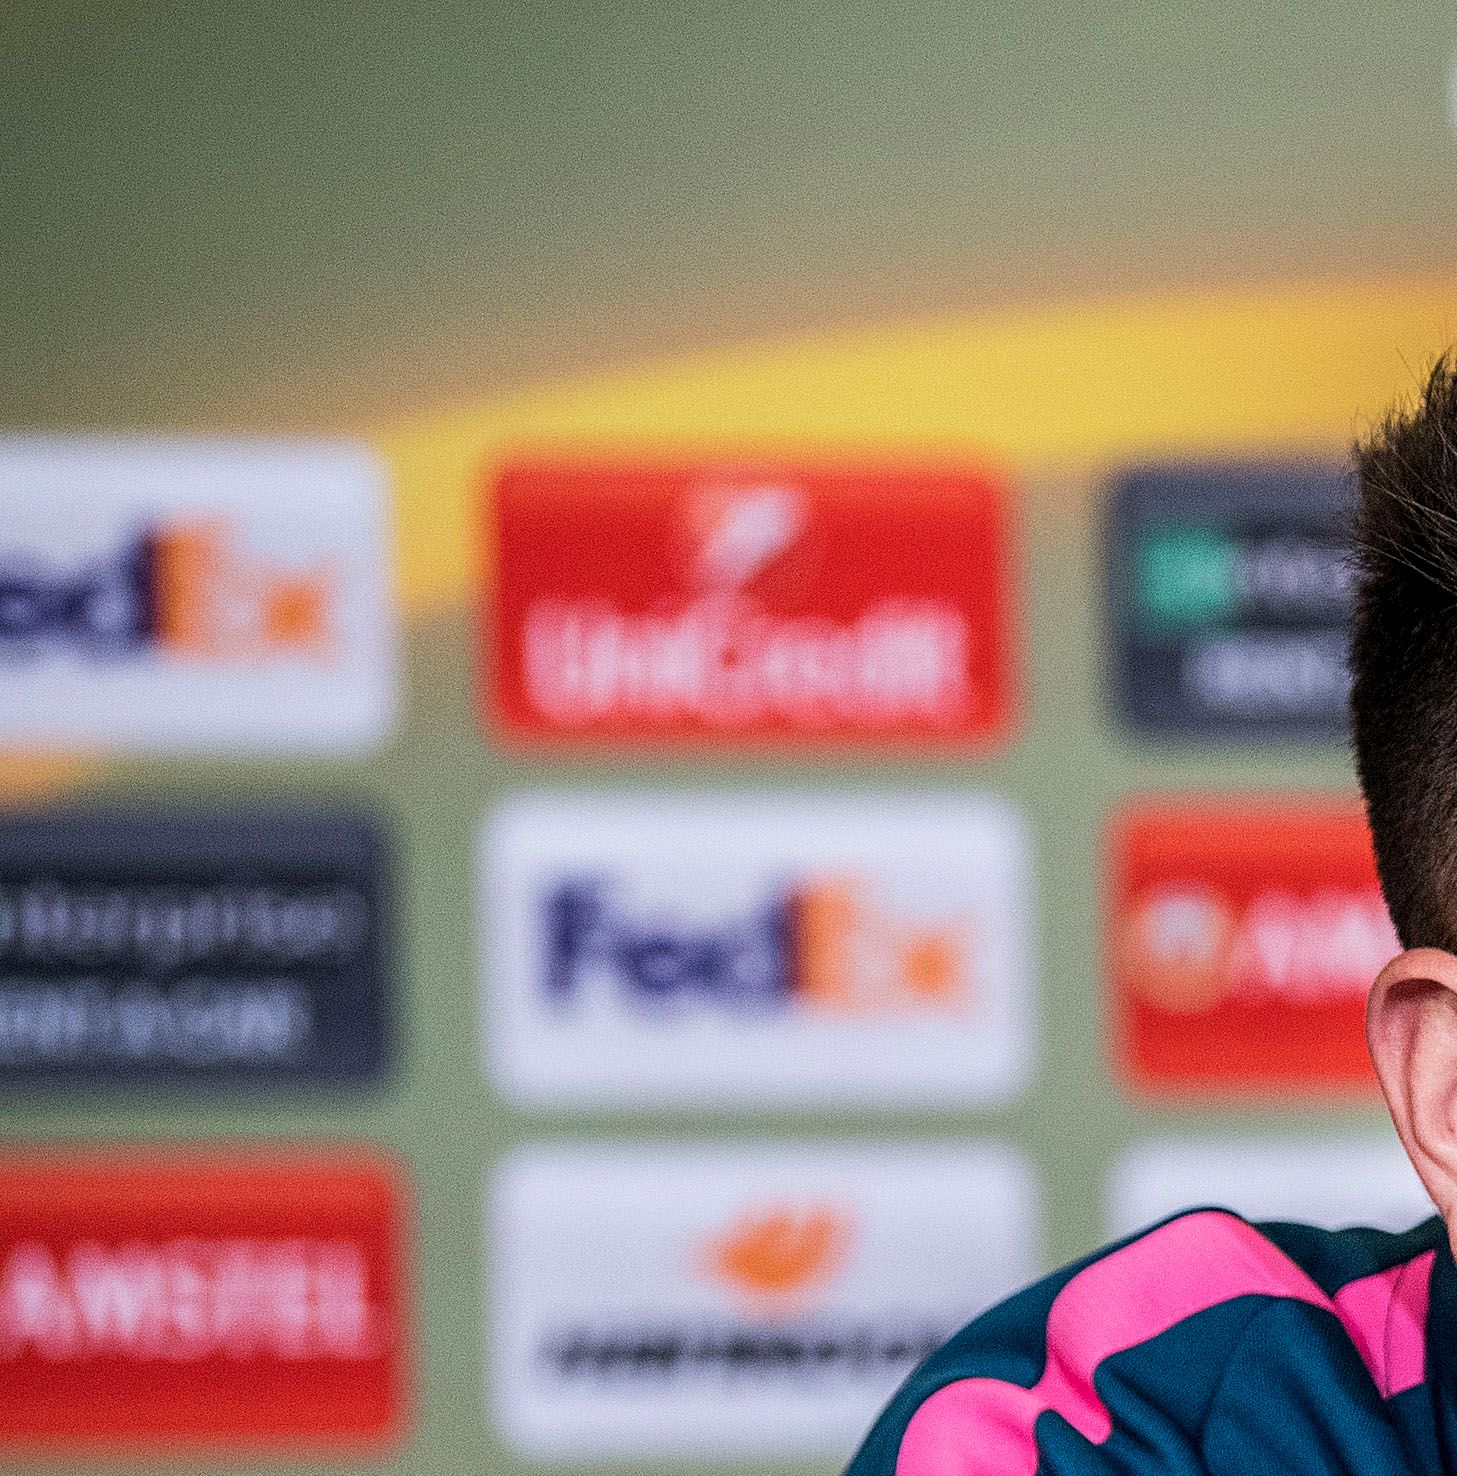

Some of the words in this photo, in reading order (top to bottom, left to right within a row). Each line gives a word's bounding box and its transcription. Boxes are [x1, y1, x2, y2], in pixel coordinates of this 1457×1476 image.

[0, 515, 338, 668] edEx
[524, 598, 970, 724] UniCredit
[538, 865, 968, 1018] FedEx
[0, 1238, 375, 1362] AMSTEL
